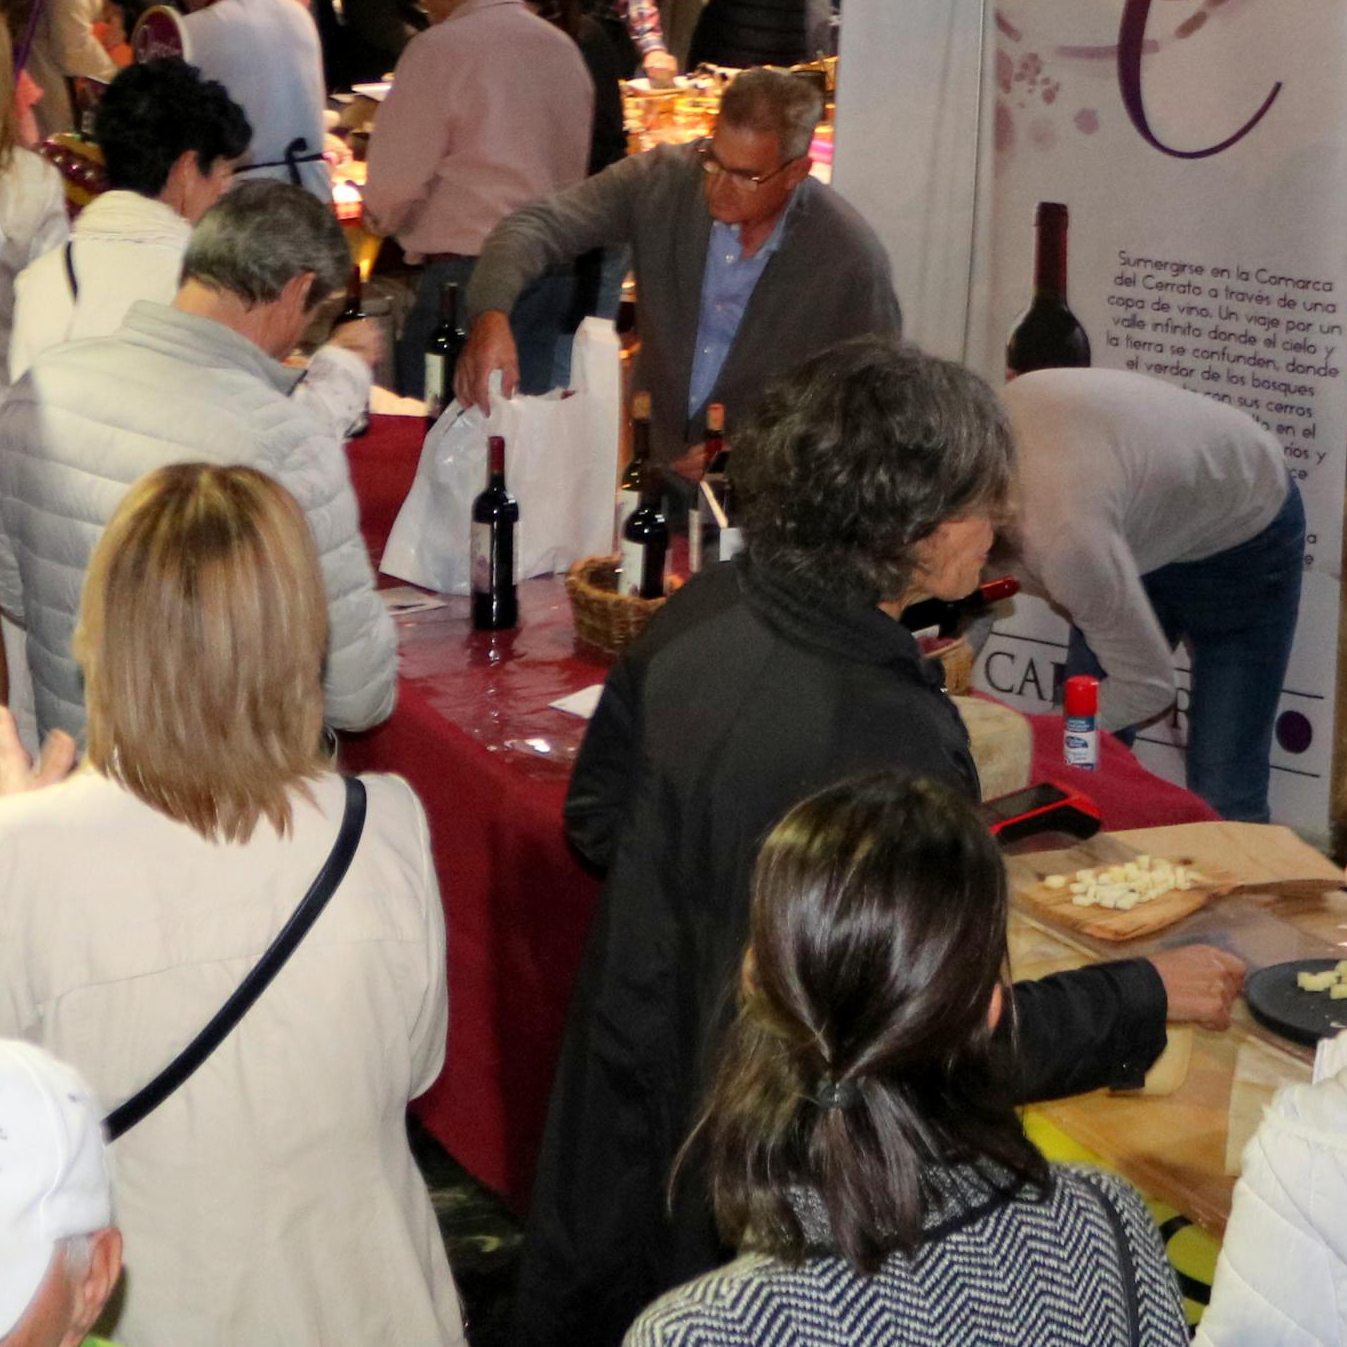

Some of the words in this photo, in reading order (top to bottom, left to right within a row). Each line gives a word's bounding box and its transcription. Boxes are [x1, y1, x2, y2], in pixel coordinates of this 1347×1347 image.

[1118, 250, 1205, 277] Sumergirse
[1210, 266, 1231, 279] en
[1236, 265, 1250, 282] la
[1255, 268, 1334, 293] Comarca
[1114, 271, 1137, 288] del
[1142, 274, 1202, 297] Cerrato
[1208, 287, 1219, 299] a
[1224, 285, 1271, 307] través
[1277, 294, 1298, 310] de
[1303, 302, 1337, 315] una
[1107, 294, 1145, 311] copa
[1151, 298, 1171, 313] de
[1177, 306, 1213, 319] vino.
[1218, 305, 1239, 323] Un
[1245, 312, 1280, 332] viaje
[1286, 321, 1313, 335] por
[1319, 324, 1342, 336] un
[1106, 333, 1120, 348] la
[1125, 334, 1164, 353] tierra
[1170, 343, 1186, 357] se
[1192, 347, 1280, 372] confunden,
[1285, 356, 1340, 379] donde
[1113, 312, 1146, 329] valle
[1151, 318, 1202, 339] infinito
[1208, 326, 1257, 347] donde
[1263, 333, 1277, 350] el
[1281, 336, 1317, 356] cielo
[1324, 345, 1336, 361] y
[1126, 355, 1140, 371] el
[1145, 360, 1195, 379] verdor
[1201, 367, 1221, 383] de
[1226, 368, 1246, 386] los
[1251, 370, 1315, 397] bosques
[1237, 396, 1261, 410] sus
[1265, 400, 1313, 419] cerros
[1275, 423, 1297, 437] en
[1302, 422, 1317, 439] el
[1316, 451, 1327, 466] y
